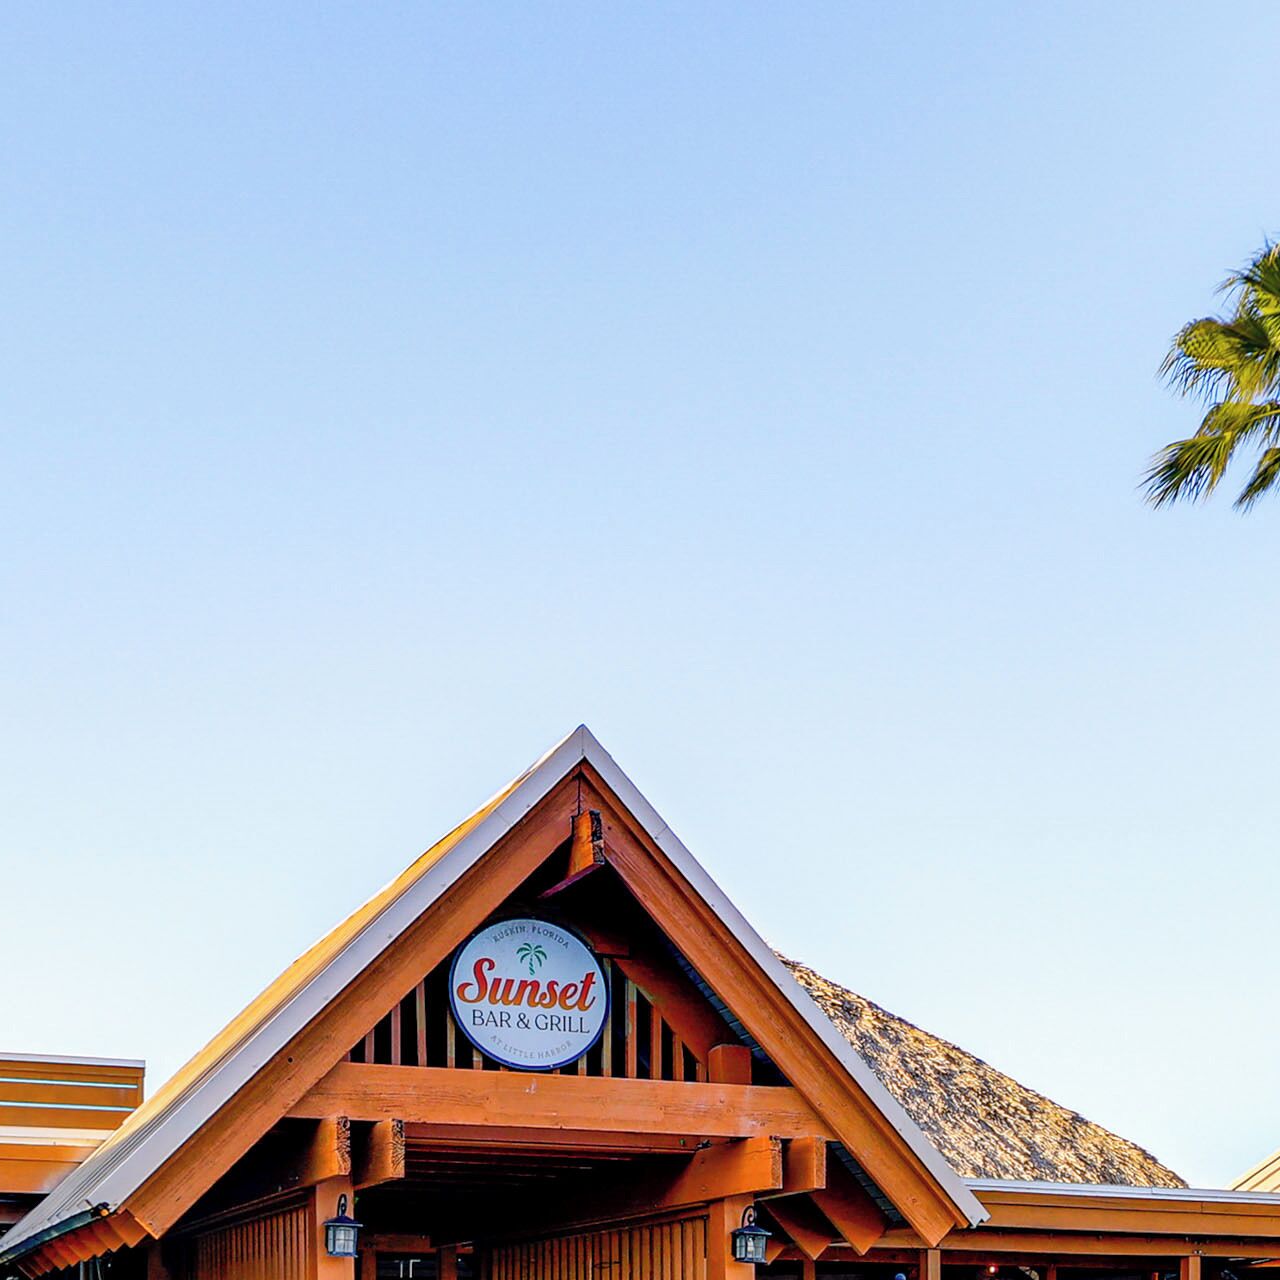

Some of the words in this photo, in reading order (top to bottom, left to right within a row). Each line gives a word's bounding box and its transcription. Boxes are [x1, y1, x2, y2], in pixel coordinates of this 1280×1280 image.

[532, 926, 569, 949] FLORIDA
[456, 957, 596, 1012] Sunset
[472, 1009, 511, 1028] BAR
[516, 1012, 531, 1030] &
[534, 1014, 590, 1034] GRILL
[503, 1044, 535, 1058] LITTLE
